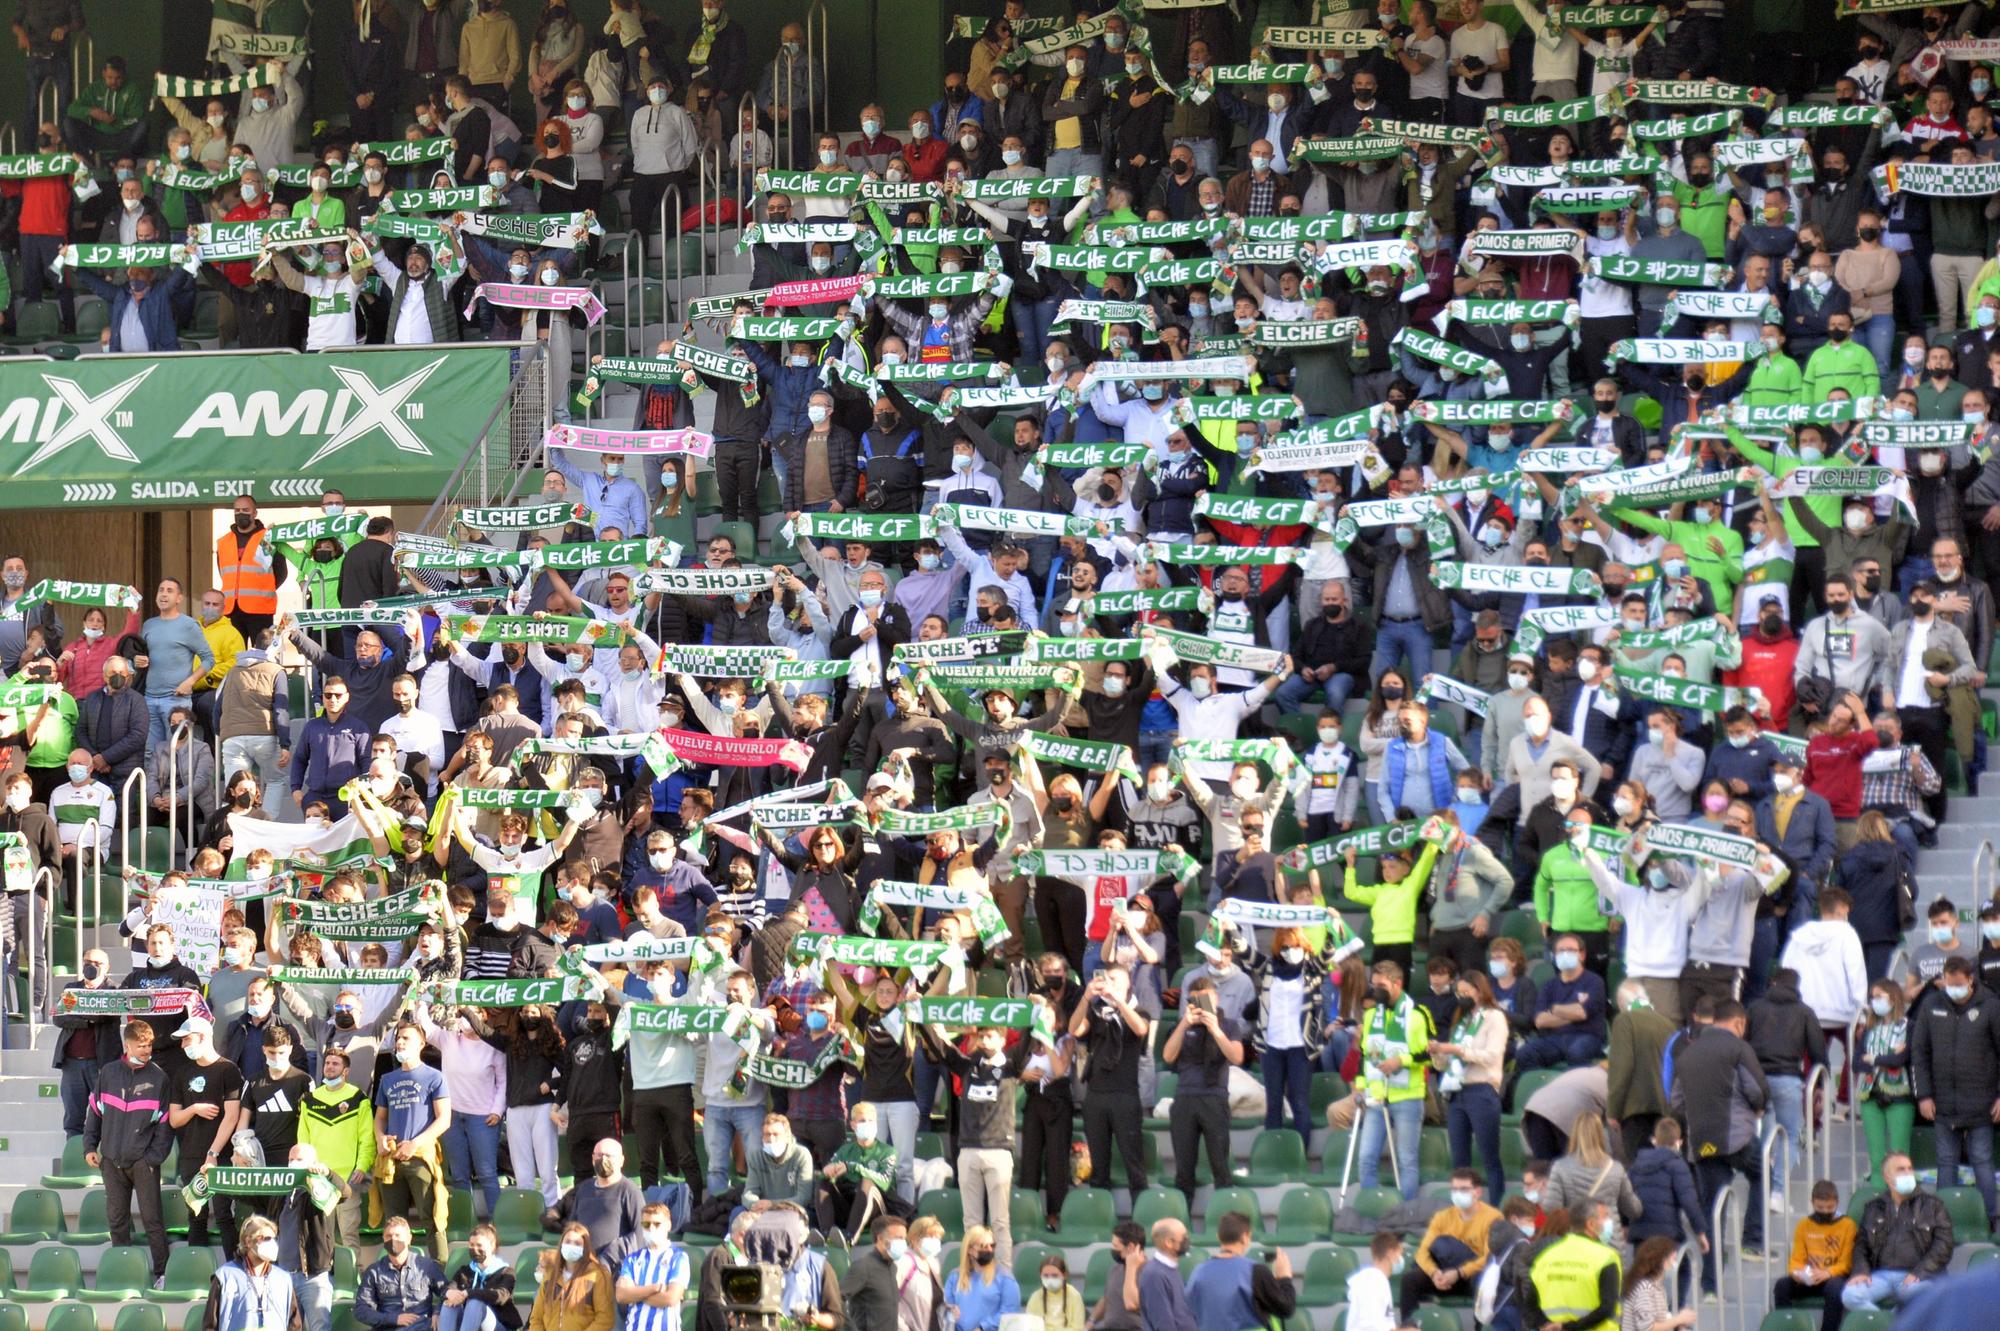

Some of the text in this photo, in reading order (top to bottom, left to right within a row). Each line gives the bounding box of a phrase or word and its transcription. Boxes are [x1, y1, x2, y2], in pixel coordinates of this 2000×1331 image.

[1648, 83, 1740, 99] ELCHE CF
[1503, 100, 1589, 124] ELCHE CF
[1787, 105, 1870, 125] ELCHE CF
[1382, 121, 1479, 141] ELCHE CF
[1637, 112, 1723, 139] ELCHE CF
[50, 155, 73, 173] CF
[1572, 157, 1624, 174] ELCHE
[772, 174, 856, 193] ELCHE CF
[863, 183, 920, 199] ELCHE
[981, 177, 1070, 196] ELCHE CF
[542, 223, 568, 240] CF
[1141, 220, 1191, 240] ELCHE
[1250, 213, 1339, 239] ELCHE CF
[1510, 232, 1525, 248] de
[1526, 234, 1578, 250] PRIMERA
[1055, 250, 1145, 269] ELCHE CF
[1143, 262, 1194, 284] ELCHE
[880, 275, 966, 295] ELCHE CF
[551, 290, 580, 305] CF
[1471, 300, 1565, 320] ELCHE CF
[748, 319, 837, 339] ELCHE CF
[1262, 324, 1328, 342] ELCHE
[673, 345, 729, 373] ELCHE
[1403, 332, 1487, 370] ELCHE CF
[894, 363, 946, 379] ELCHE
[173, 354, 450, 471] AMIX
[1198, 397, 1293, 417] ELCHE CF
[1442, 402, 1550, 421] ELCHE CF
[1753, 400, 1851, 421] ELCHE CF
[1334, 414, 1366, 438] CF
[650, 436, 680, 449] CF
[1108, 445, 1142, 461] CF
[131, 480, 256, 499] SALIDA EXIT
[1673, 477, 1684, 490] A
[462, 506, 562, 526] ELCHE CF
[1211, 500, 1300, 522] ELCHE CF
[277, 515, 356, 540] ELCHE CF
[817, 518, 914, 538] ELCHE CF
[548, 543, 643, 567] ELCHE CF
[1100, 587, 1194, 612] ELCHE CF
[296, 610, 365, 623] ELCHE
[1043, 640, 1097, 659] ELCHE
[985, 665, 996, 677] A
[1681, 685, 1719, 706] CF
[1311, 824, 1416, 866] ELCHE CF
[1684, 835, 1698, 849] de
[311, 893, 411, 922] ELCHE CF
[837, 941, 945, 963] ELCHE CF
[346, 968, 354, 979] A
[461, 981, 561, 1004] ELCHE CF
[635, 1007, 729, 1030] ELCHE CF
[927, 1002, 1030, 1023] ELCHE CF
[45, 1086, 52, 1096] 7
[215, 1170, 297, 1187] ILICITANO
